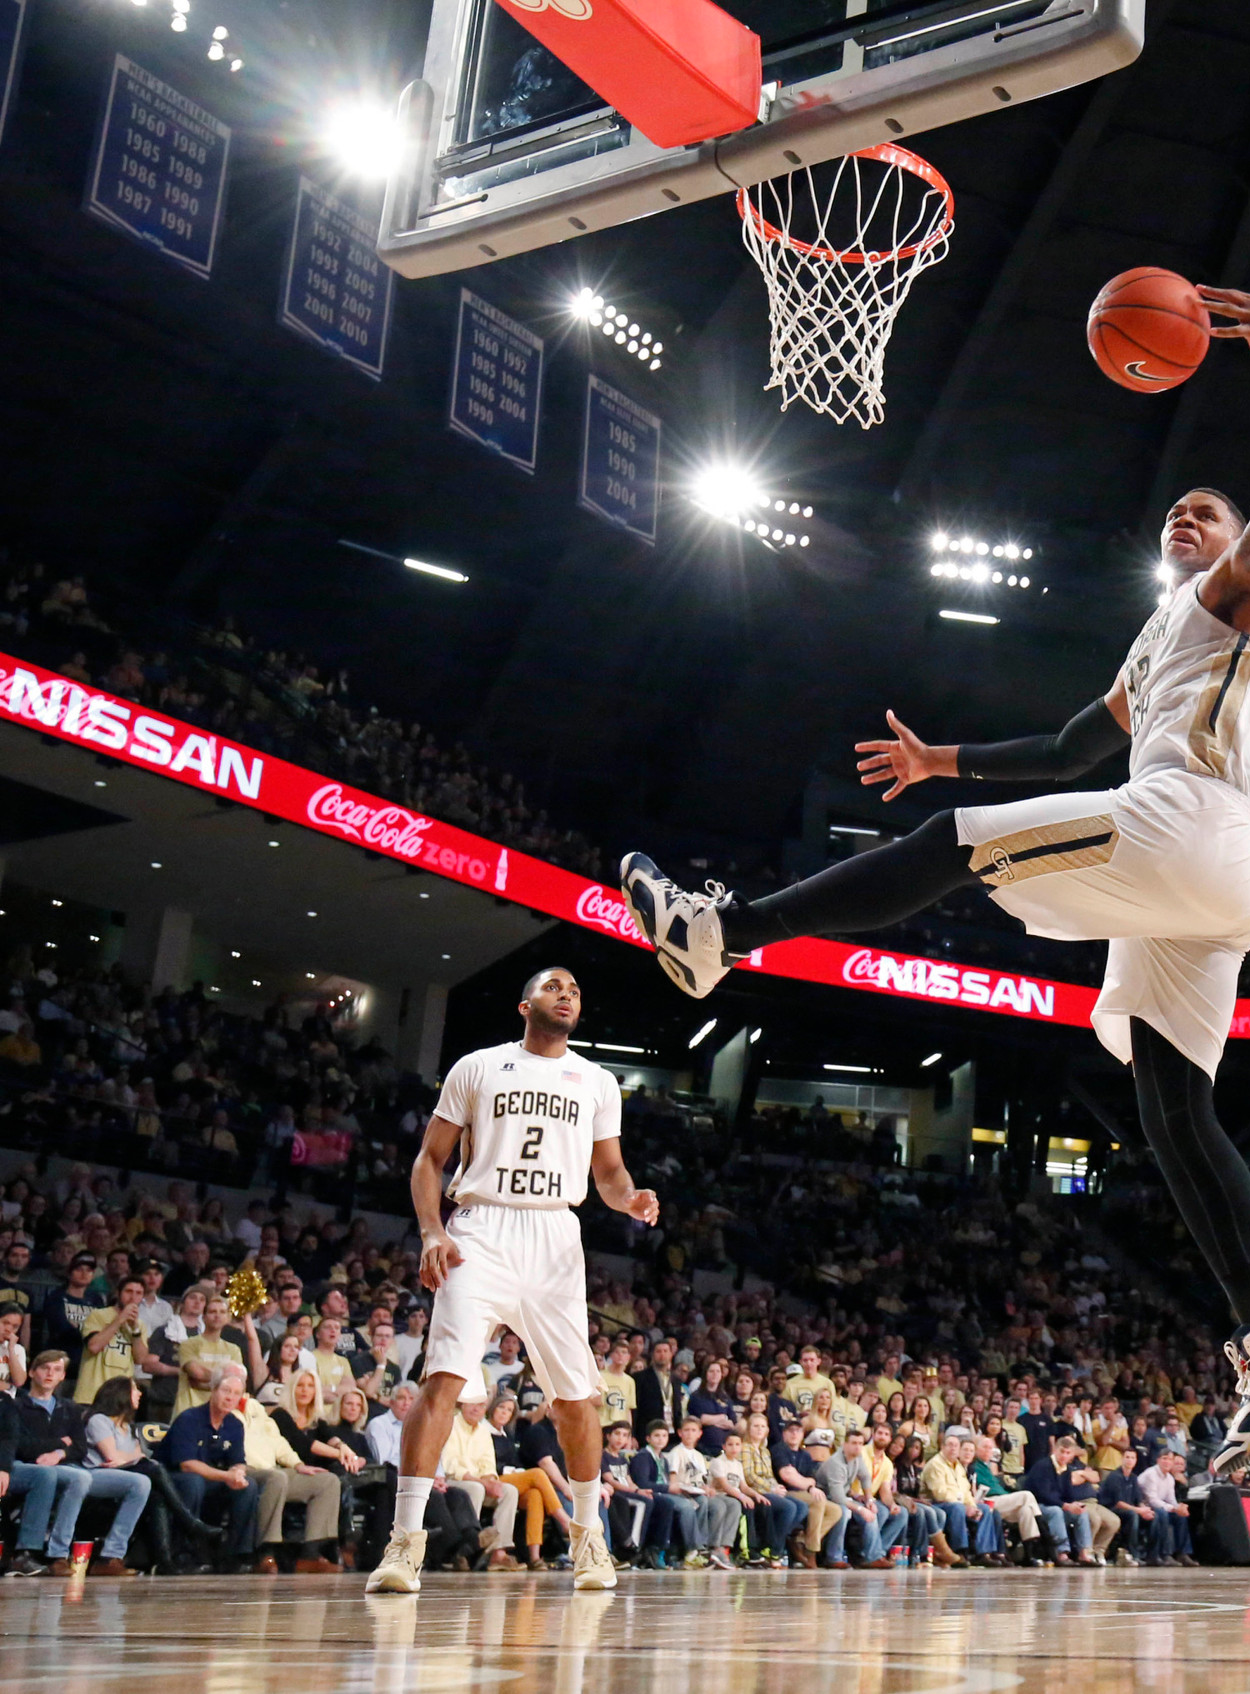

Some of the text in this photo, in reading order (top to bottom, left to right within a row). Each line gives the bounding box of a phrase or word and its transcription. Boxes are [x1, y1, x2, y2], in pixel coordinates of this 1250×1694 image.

[130, 102, 166, 138] 1960
[127, 128, 203, 190] 1985 1989
[122, 154, 199, 217] 1986 1990
[117, 180, 152, 215] 1987
[160, 207, 193, 241] 1991
[313, 221, 379, 278] 1992 2004
[307, 268, 372, 324] 1996 2007
[345, 269, 375, 301] 2005
[304, 293, 369, 347] 2001 2010
[471, 351, 526, 399] 1985 1996
[473, 328, 528, 376] 1960 1992
[468, 398, 494, 426] 1990
[469, 374, 526, 423] 1986 2004
[609, 421, 636, 454] 1985
[608, 449, 635, 481] 1990
[606, 476, 636, 510] 2004
[8, 667, 264, 800] NISSAN
[307, 784, 487, 882] Coca-Cola zero
[878, 956, 1055, 1017] NISSAN
[494, 1091, 580, 1126] GEORGIA
[521, 1126, 544, 1160] 2
[496, 1167, 562, 1197] TECH
